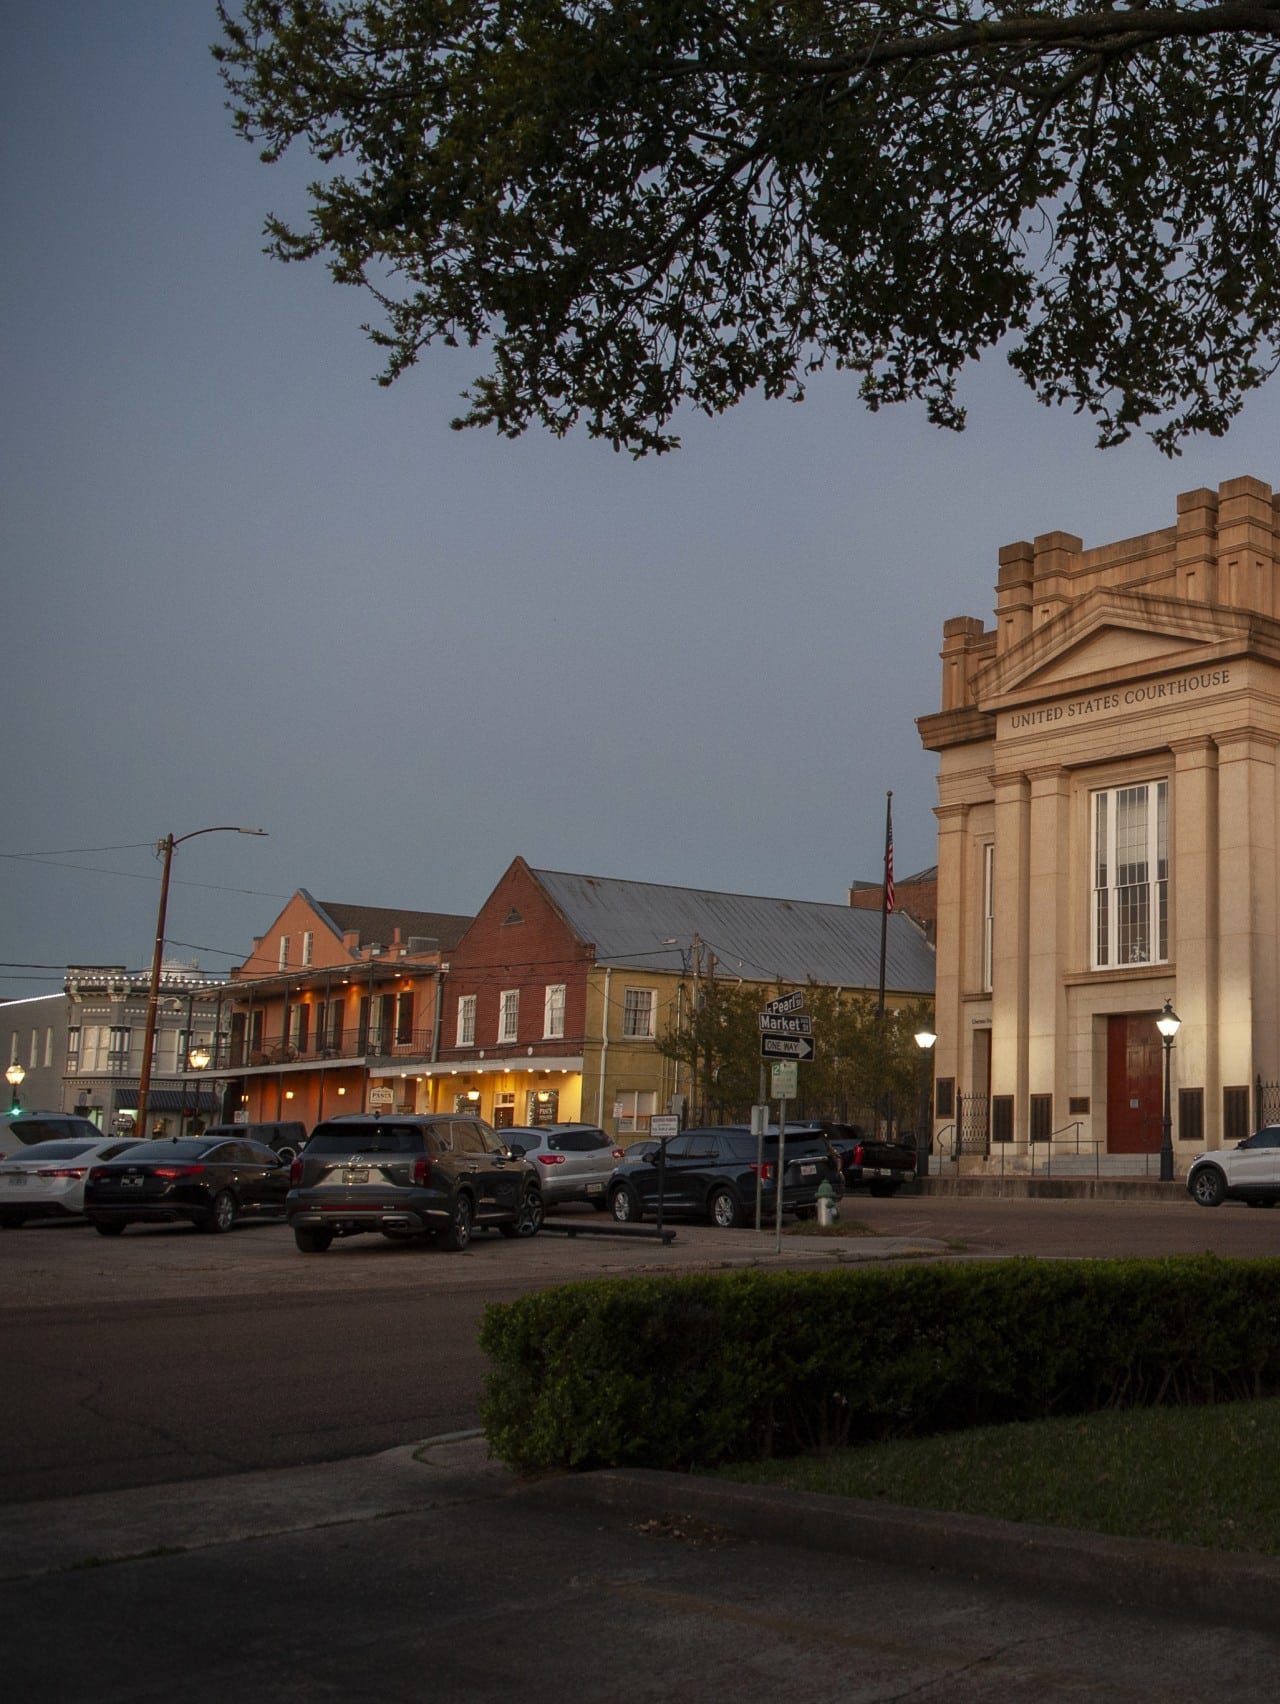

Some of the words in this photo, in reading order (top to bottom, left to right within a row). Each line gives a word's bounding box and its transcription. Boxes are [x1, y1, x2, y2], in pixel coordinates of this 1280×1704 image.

[1011, 706, 1063, 729] UNITED
[1067, 693, 1119, 717] STATES
[1124, 670, 1231, 705] COURTHOUSE
[772, 995, 795, 1014] Pearl
[761, 1015, 801, 1031] Market
[767, 1040, 782, 1051] ONE
[784, 1041, 799, 1052] WAY
[774, 1065, 780, 1074] 2
